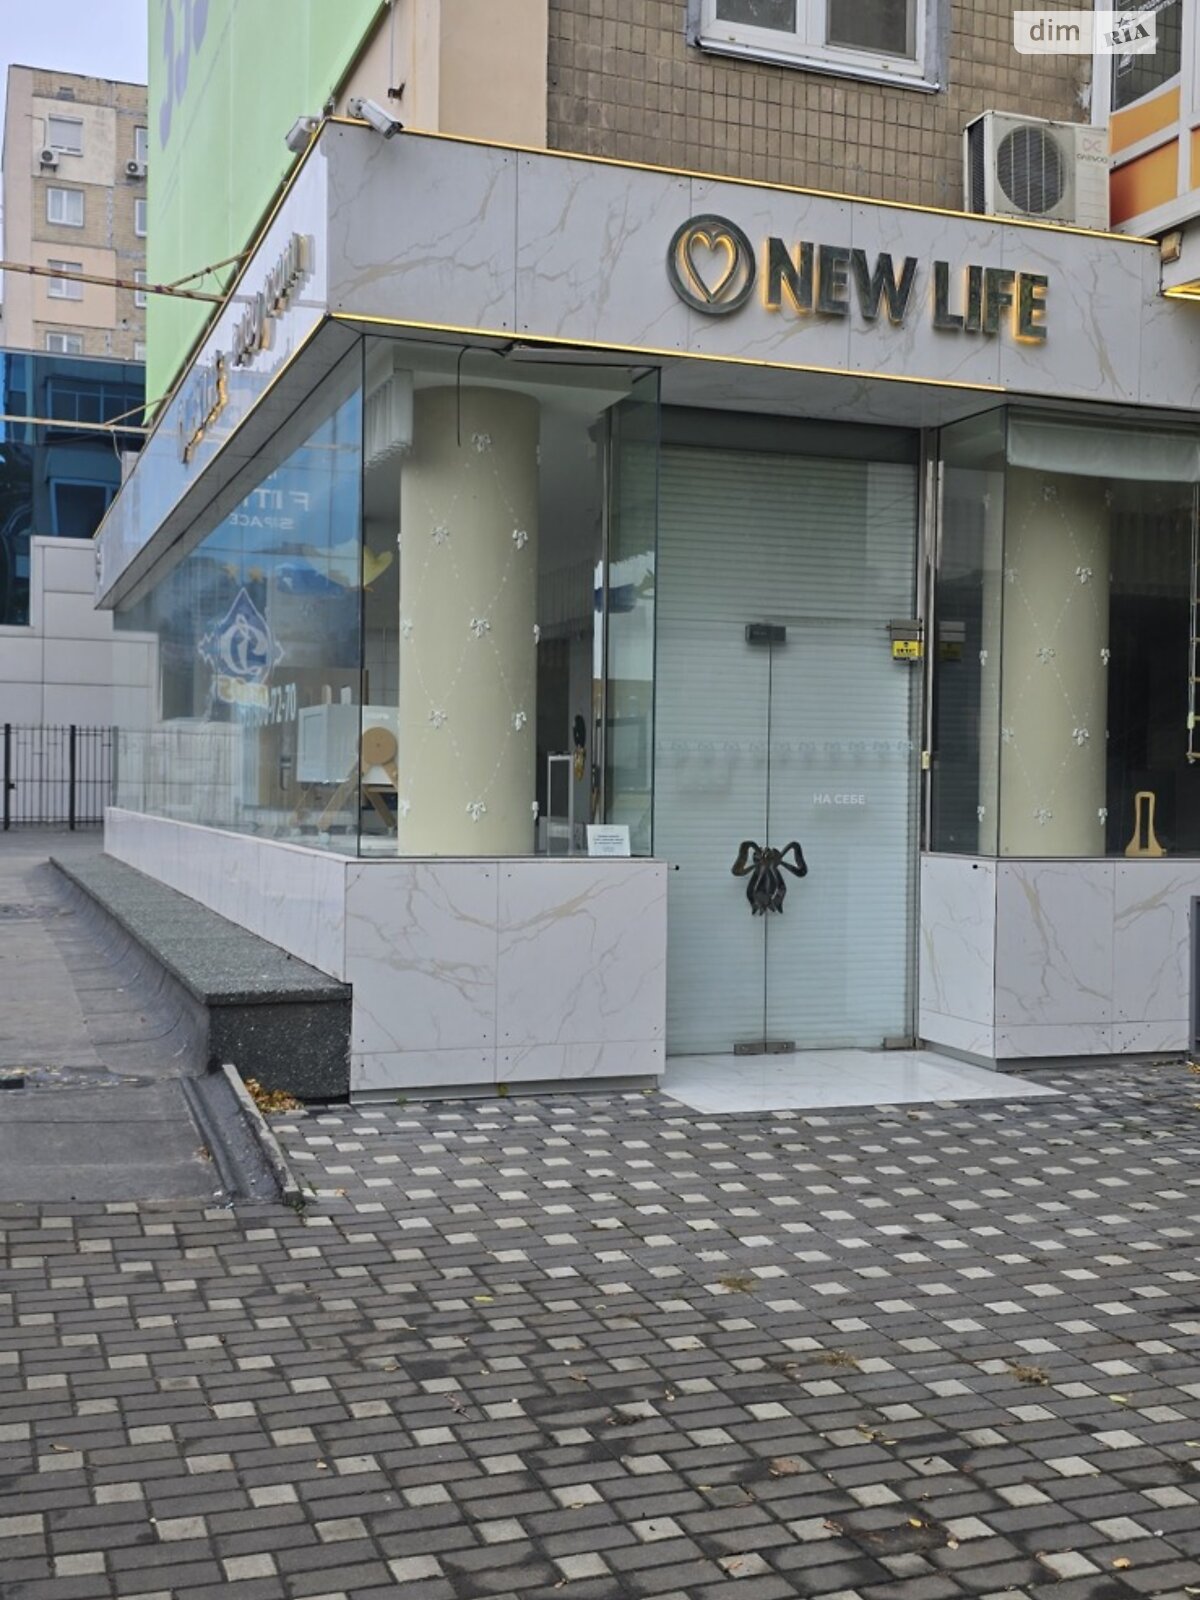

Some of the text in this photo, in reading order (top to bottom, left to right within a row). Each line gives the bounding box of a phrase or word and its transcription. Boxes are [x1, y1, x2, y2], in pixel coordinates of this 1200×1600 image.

[764, 236, 1049, 343] NEW LIFE
[813, 793, 865, 805] НА СЕБЕ
